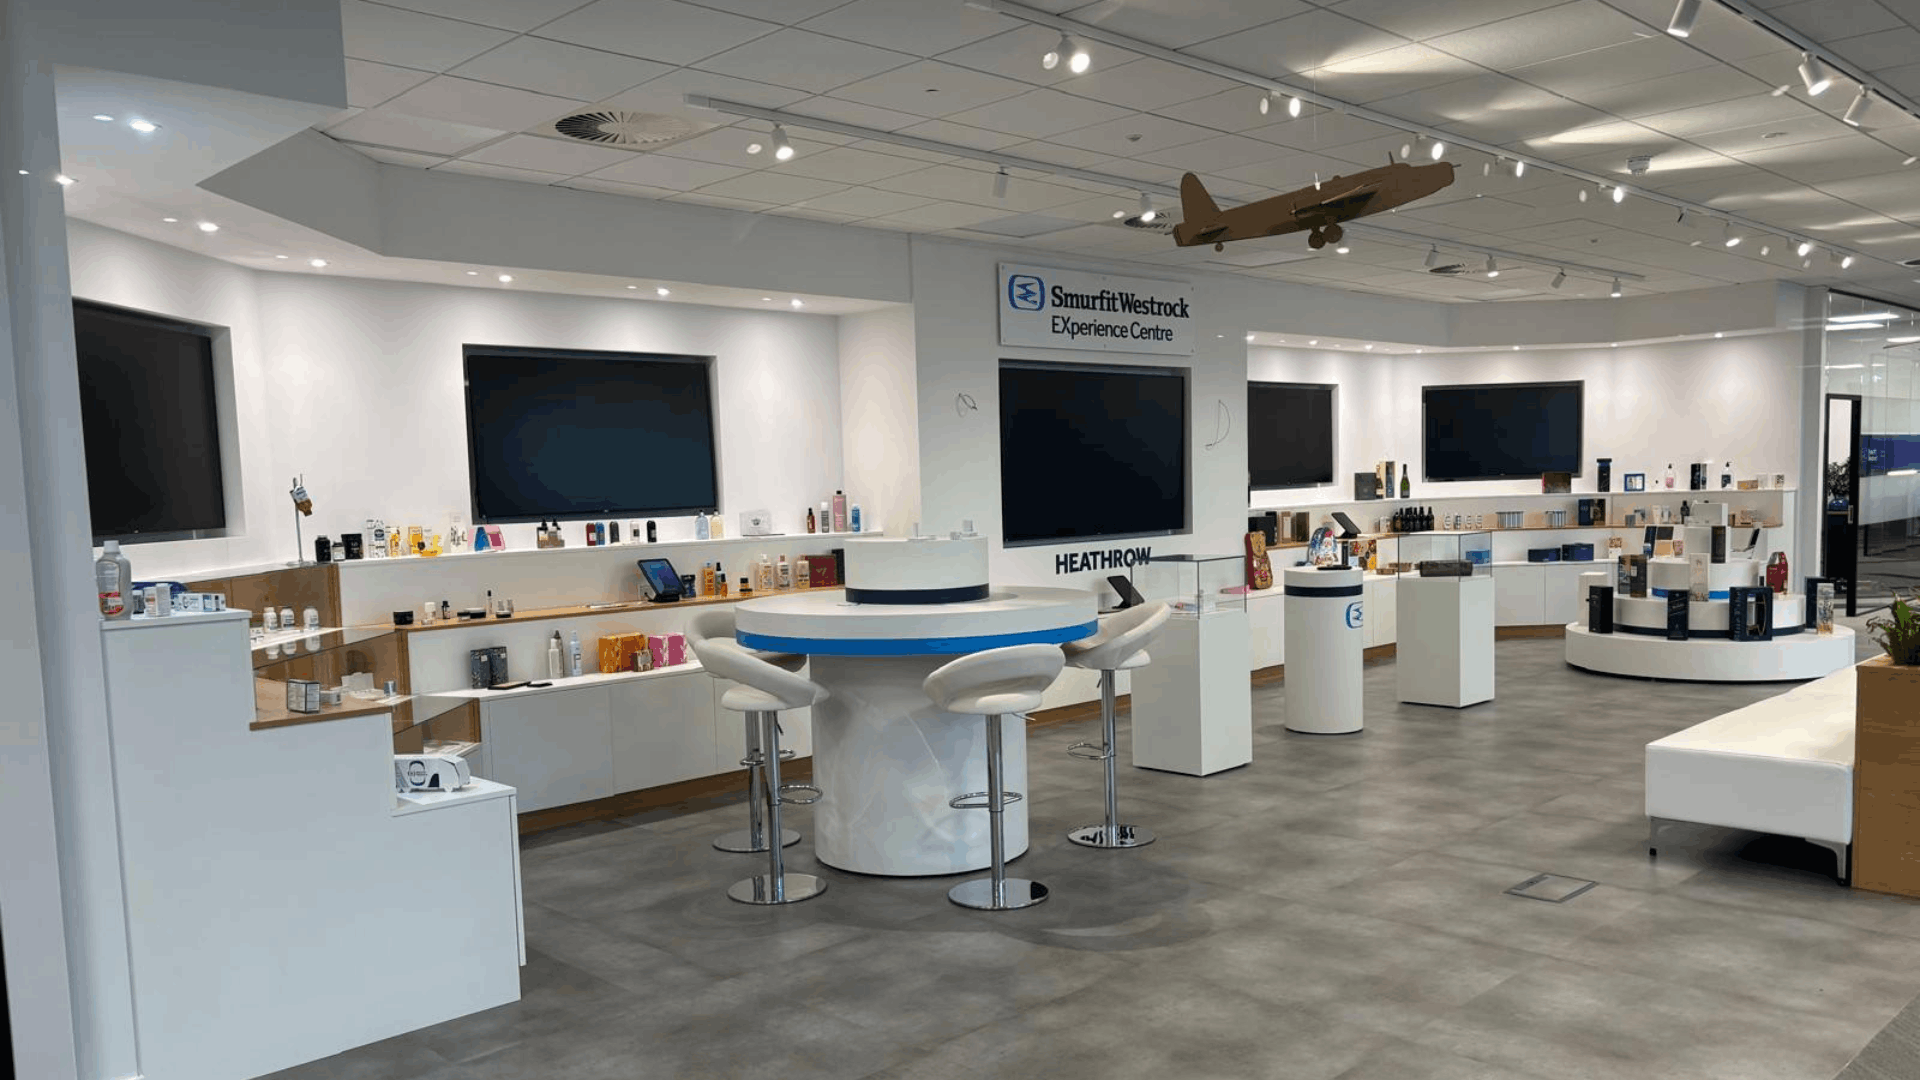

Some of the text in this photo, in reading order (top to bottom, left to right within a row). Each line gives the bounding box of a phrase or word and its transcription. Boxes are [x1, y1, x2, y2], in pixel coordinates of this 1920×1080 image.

[1052, 316, 1173, 341] EXperience Centre
[1055, 546, 1151, 575] HEATHROW
